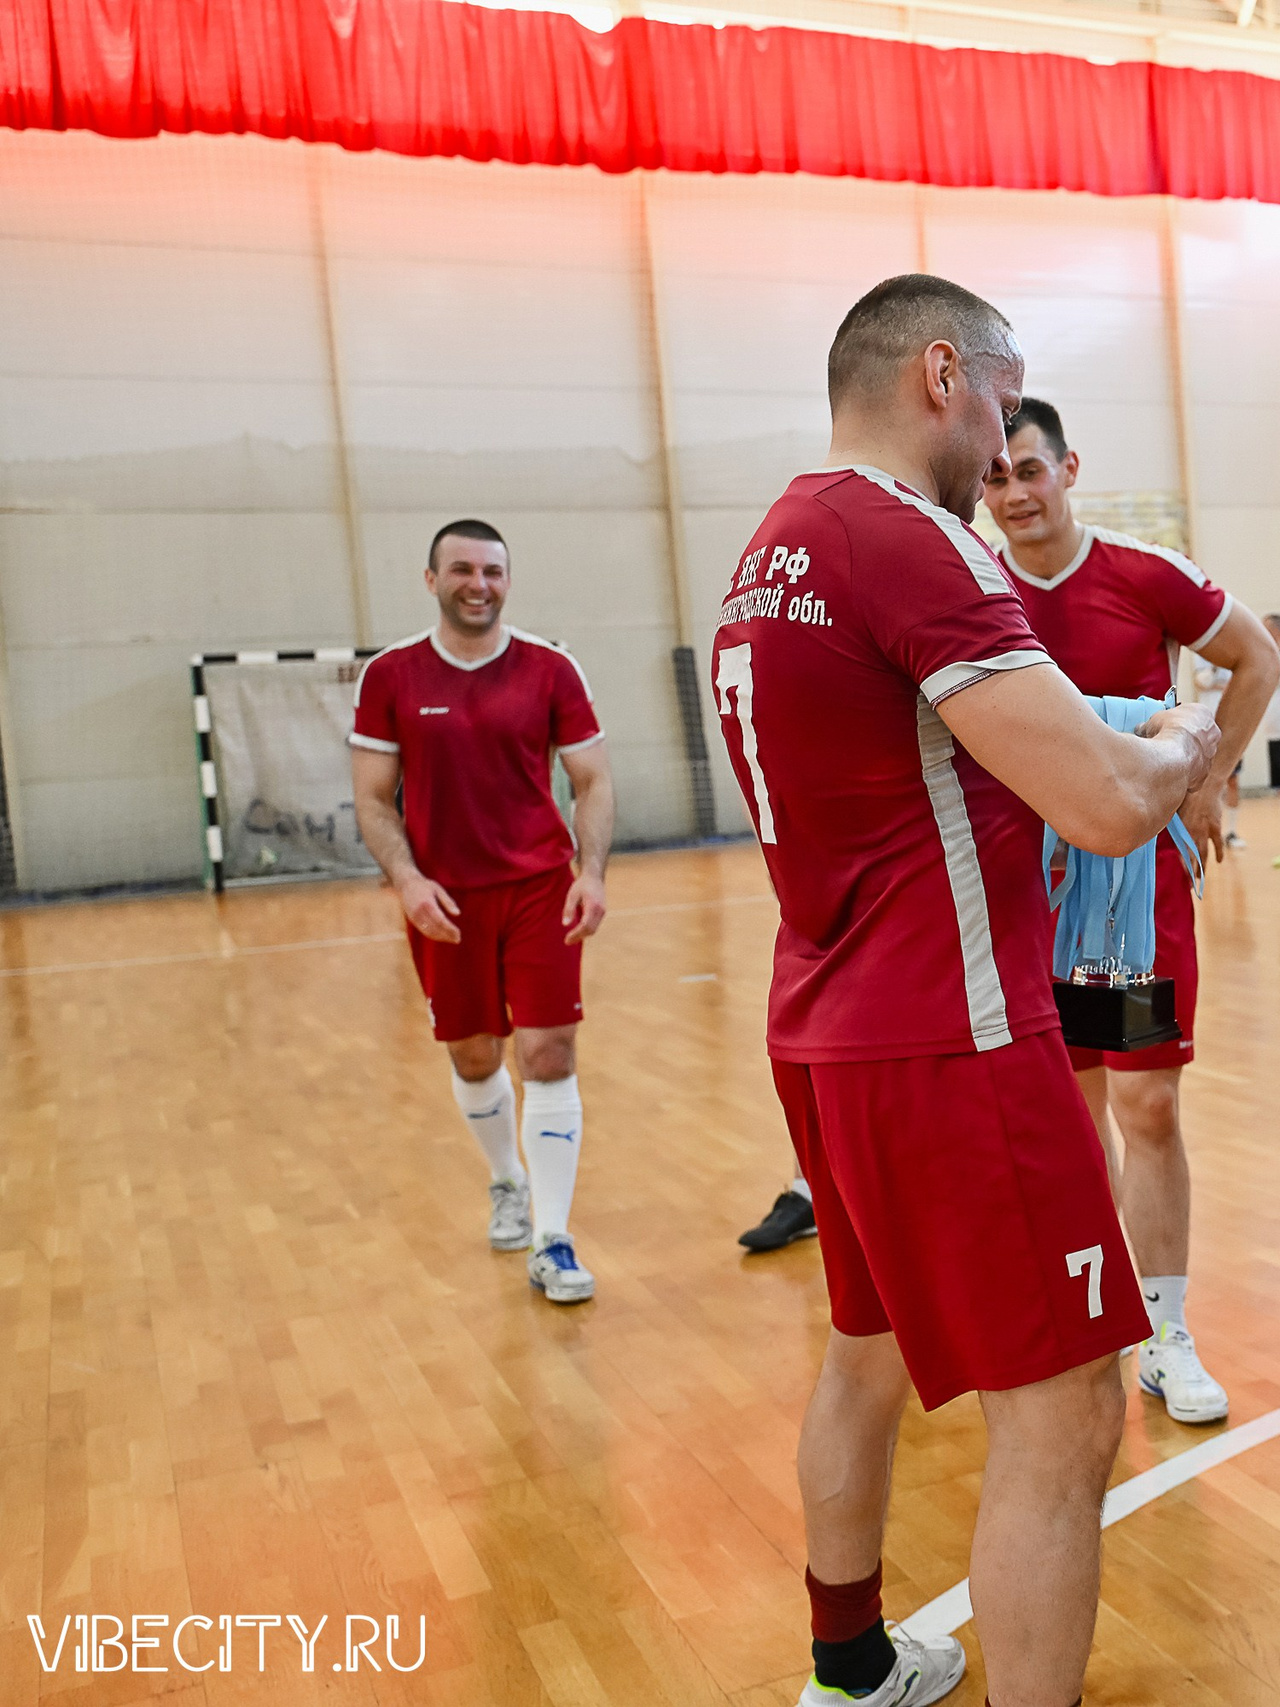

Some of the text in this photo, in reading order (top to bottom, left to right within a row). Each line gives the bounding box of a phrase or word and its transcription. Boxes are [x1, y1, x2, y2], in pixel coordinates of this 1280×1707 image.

[765, 546, 810, 584] РФ
[787, 591, 833, 627] обл.
[1065, 1243, 1105, 1320] 7
